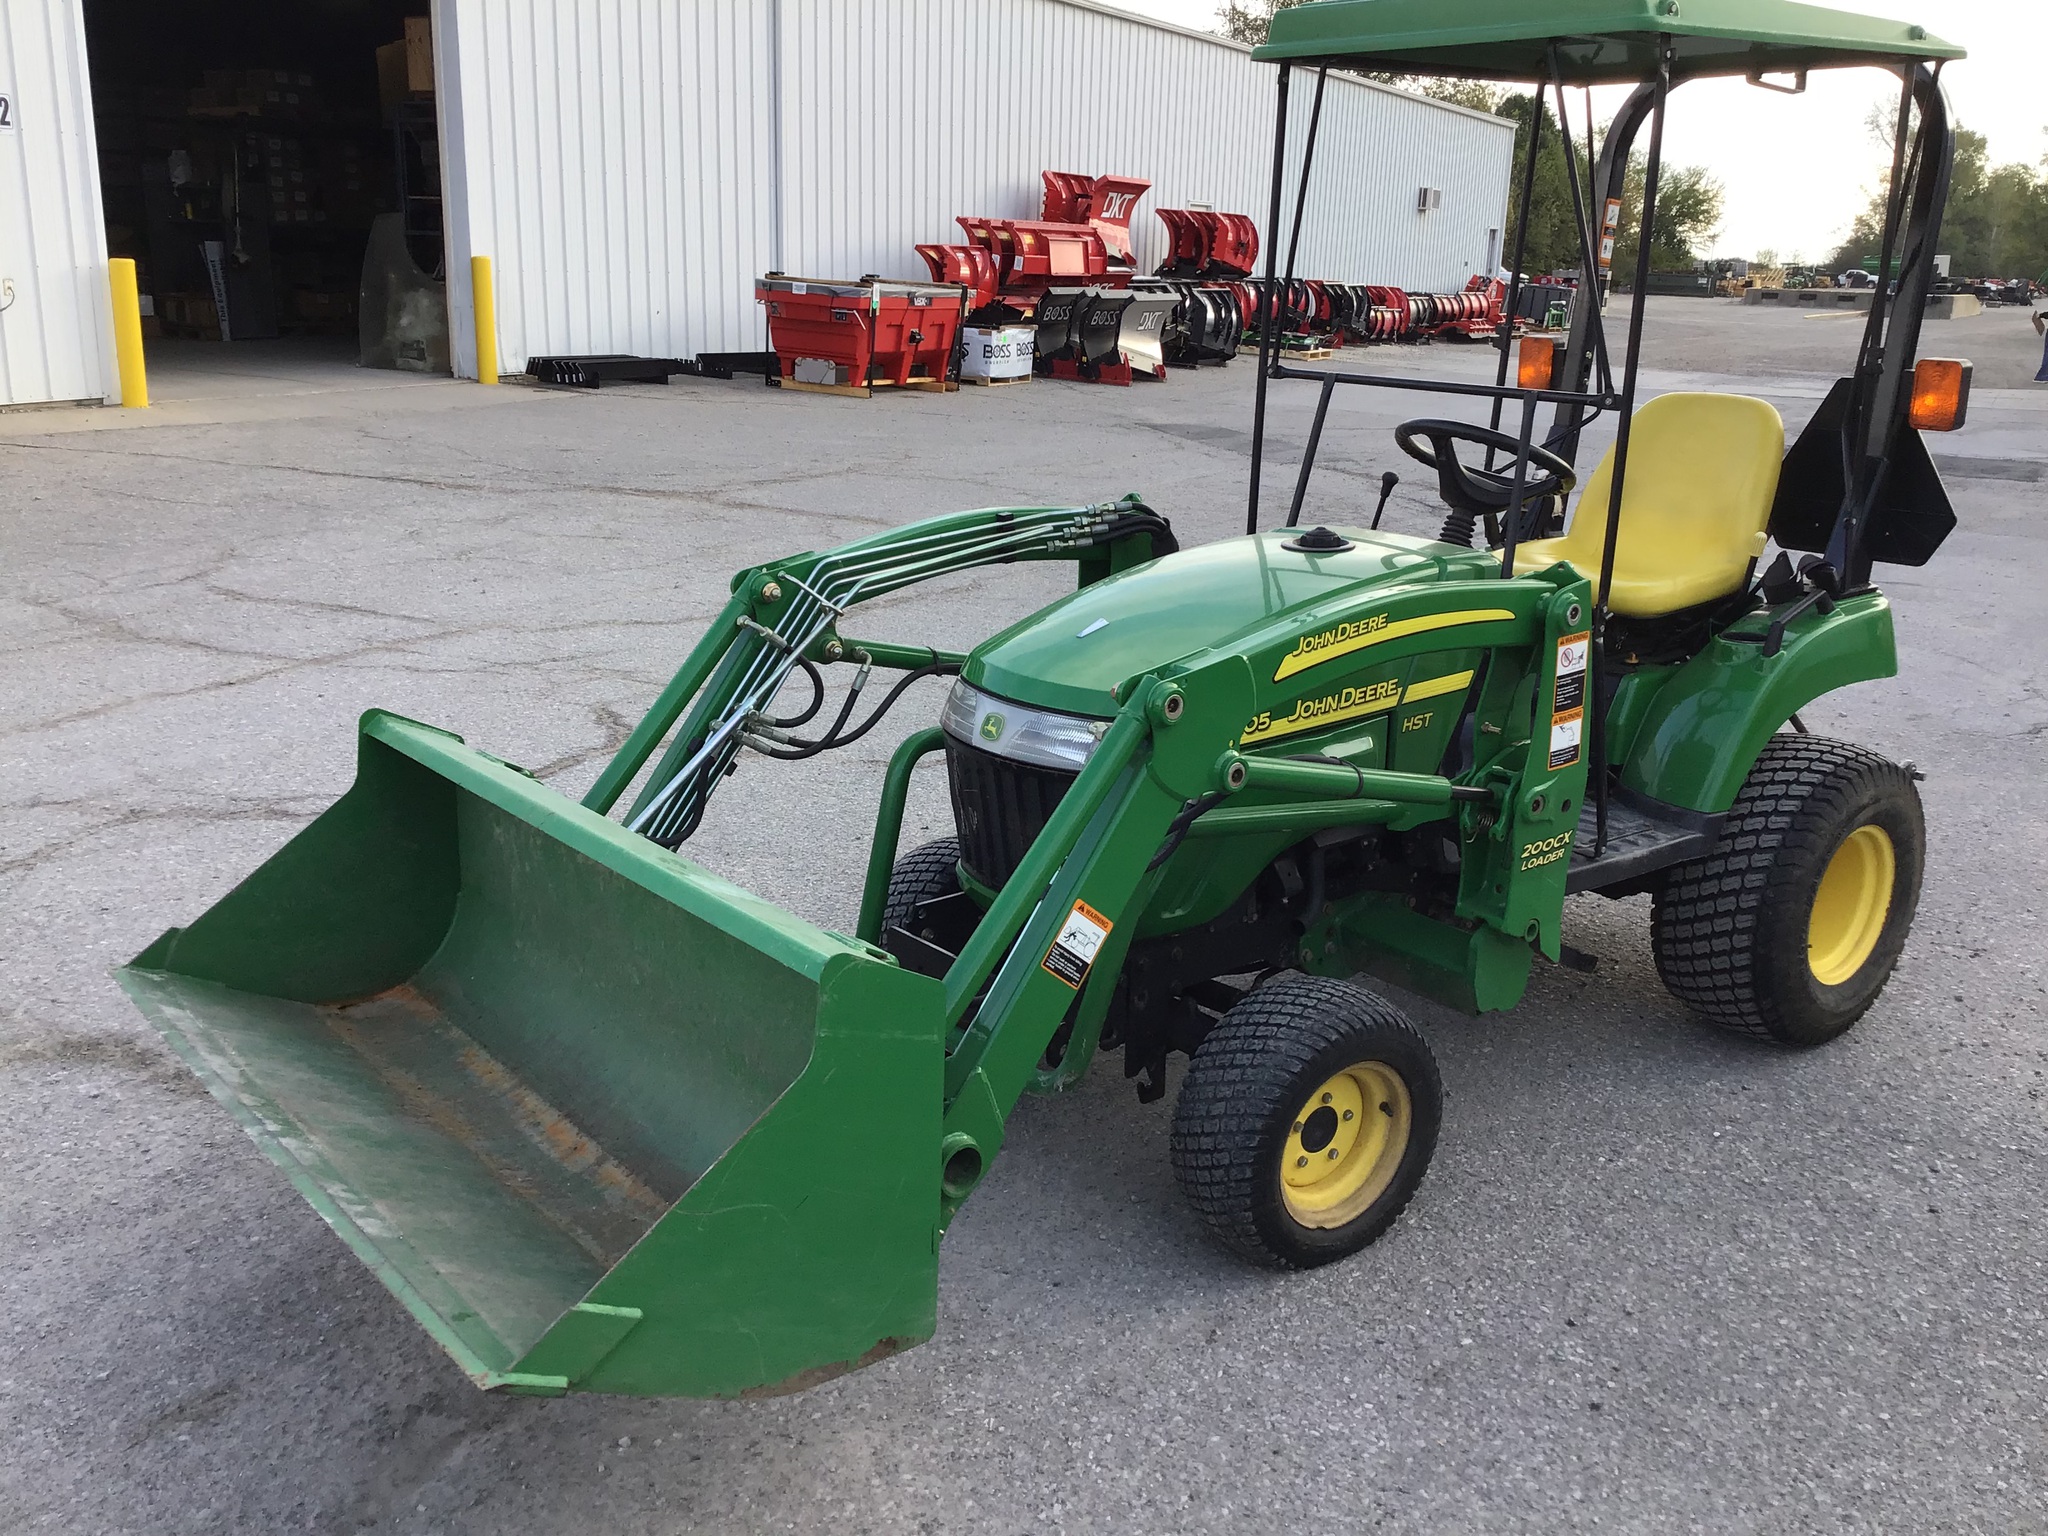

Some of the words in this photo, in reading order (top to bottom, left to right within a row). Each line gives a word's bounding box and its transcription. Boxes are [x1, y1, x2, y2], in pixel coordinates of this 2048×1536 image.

[0, 96, 11, 126] 2
[1100, 191, 1136, 219] DXT
[1042, 305, 1073, 321] BOSS
[1090, 310, 1120, 326] BOSS
[1136, 311, 1164, 331] DXT
[982, 343, 1012, 359] BOSS
[1016, 340, 1035, 357] BOSS
[1292, 629, 1336, 657] JOHN
[1336, 612, 1389, 643] DEERE
[1564, 631, 1589, 645] WARNING
[1287, 693, 1340, 723] JOHN
[1340, 678, 1399, 709] DEERE
[1402, 712, 1434, 733] HST
[1520, 829, 1574, 859] 200CX
[1520, 848, 1566, 871] LOADER
[1085, 909, 1109, 929] WARNING
